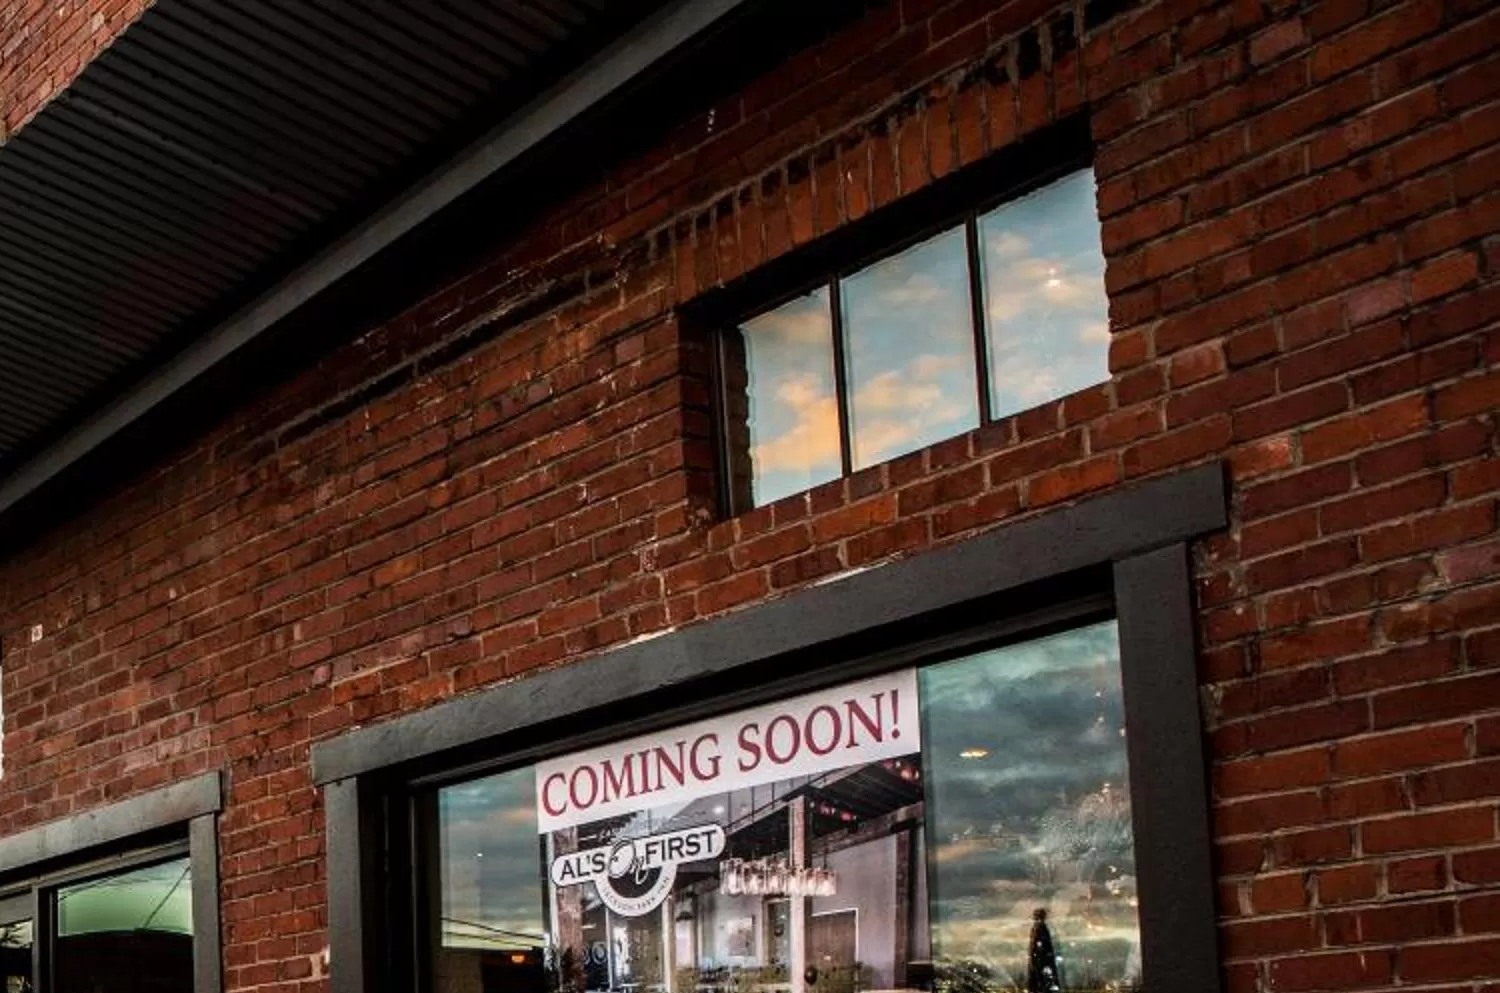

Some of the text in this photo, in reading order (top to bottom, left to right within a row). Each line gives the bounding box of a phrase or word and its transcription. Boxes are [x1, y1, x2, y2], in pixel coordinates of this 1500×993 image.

[541, 688, 902, 816] COMING SOON!
[559, 853, 605, 881] AL'S
[645, 829, 718, 866] FIRST
